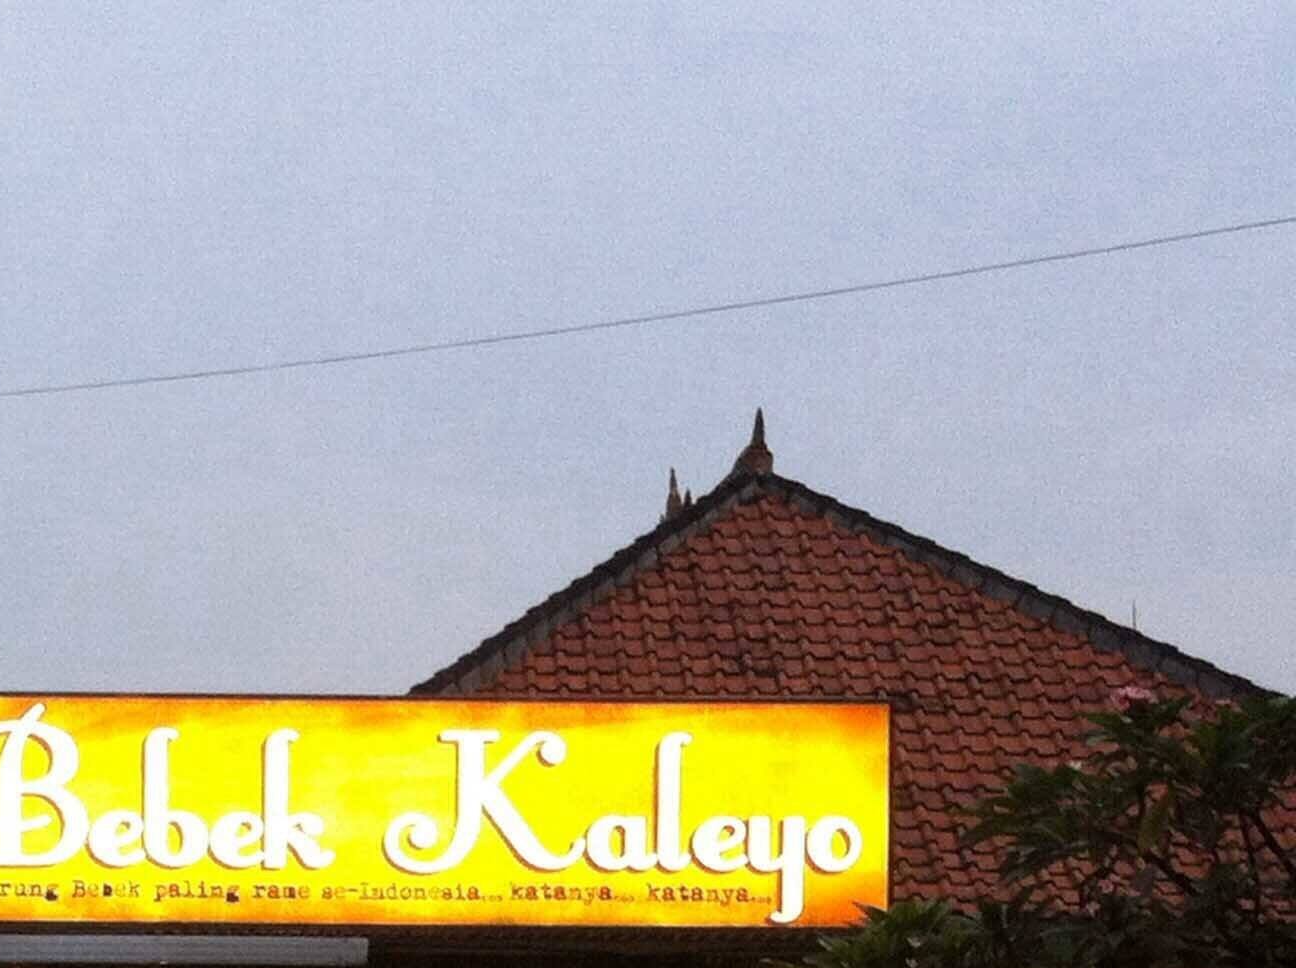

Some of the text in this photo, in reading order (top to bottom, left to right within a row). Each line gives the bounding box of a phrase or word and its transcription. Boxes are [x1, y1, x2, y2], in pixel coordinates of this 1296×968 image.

[382, 730, 862, 923] Kaleyo
[154, 880, 240, 902] paling
[252, 885, 311, 899] rame
